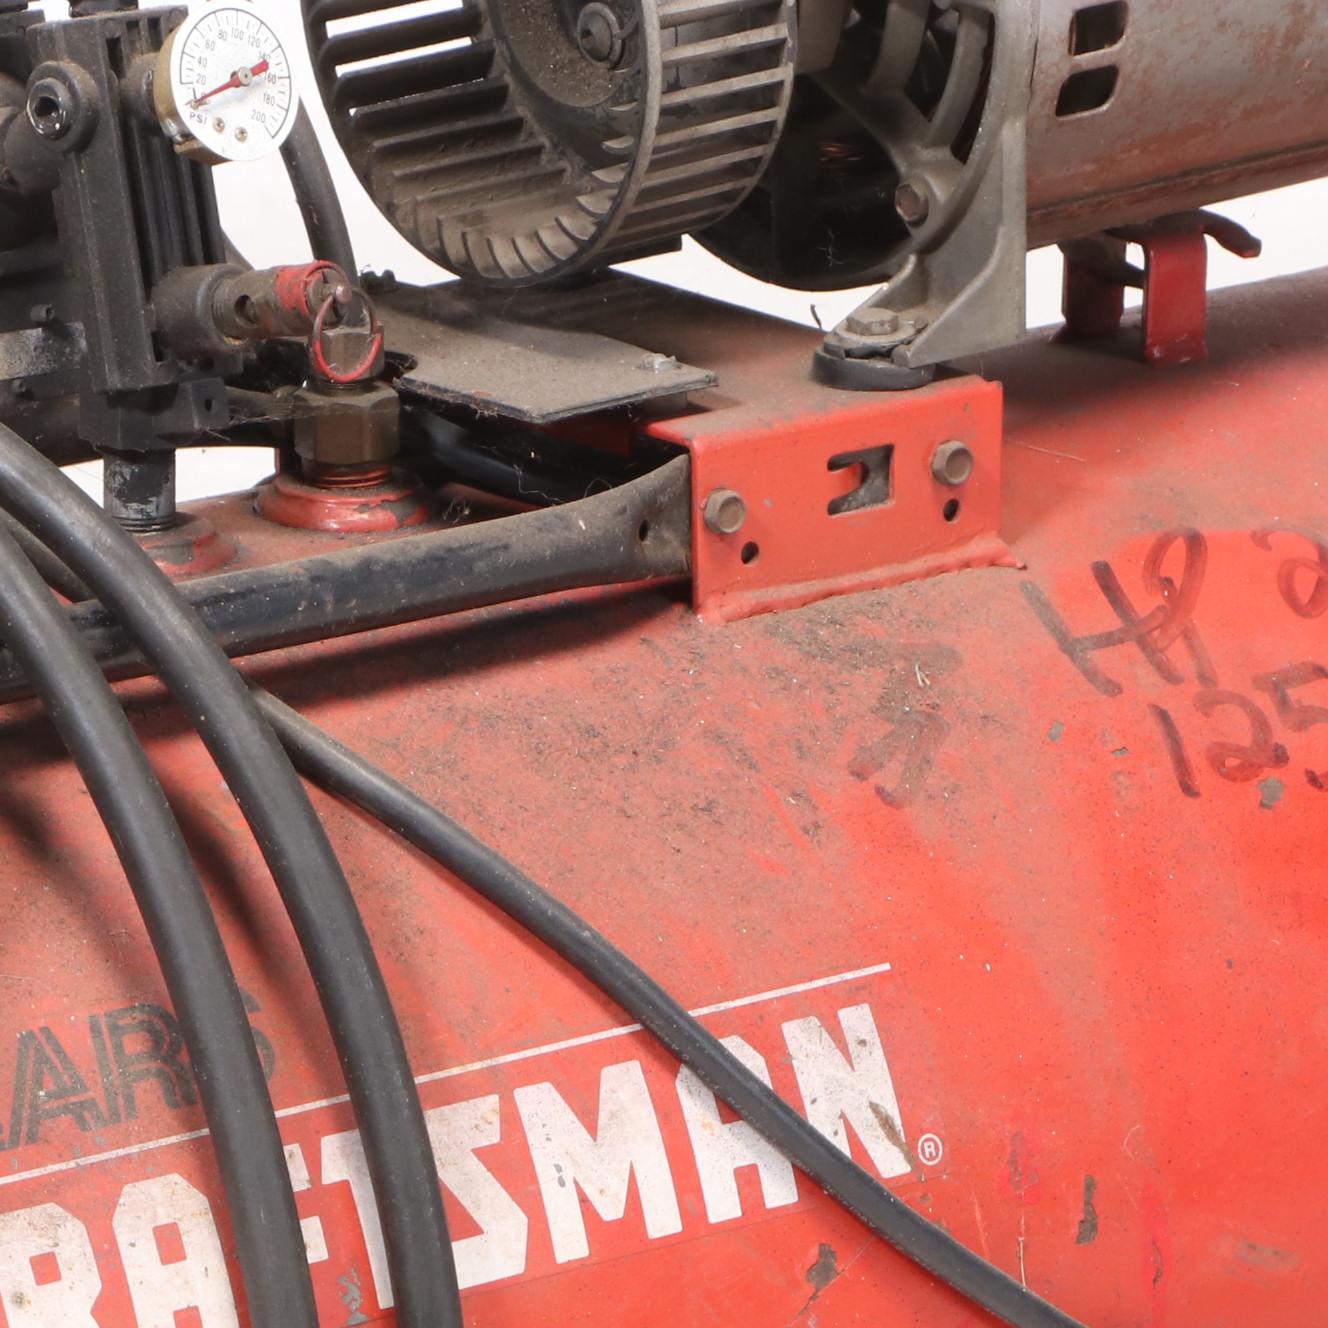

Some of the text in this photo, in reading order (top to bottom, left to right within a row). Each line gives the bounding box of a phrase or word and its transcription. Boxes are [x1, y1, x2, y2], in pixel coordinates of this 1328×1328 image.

[217, 29, 228, 41] 80
[231, 27, 244, 41] 100
[248, 34, 261, 48] 120
[205, 39, 216, 51] 60
[197, 56, 208, 68] 40
[196, 73, 207, 86] 20
[264, 70, 277, 85] 160
[263, 92, 276, 107] 180
[189, 111, 208, 126] PSI
[251, 109, 266, 124] 200
